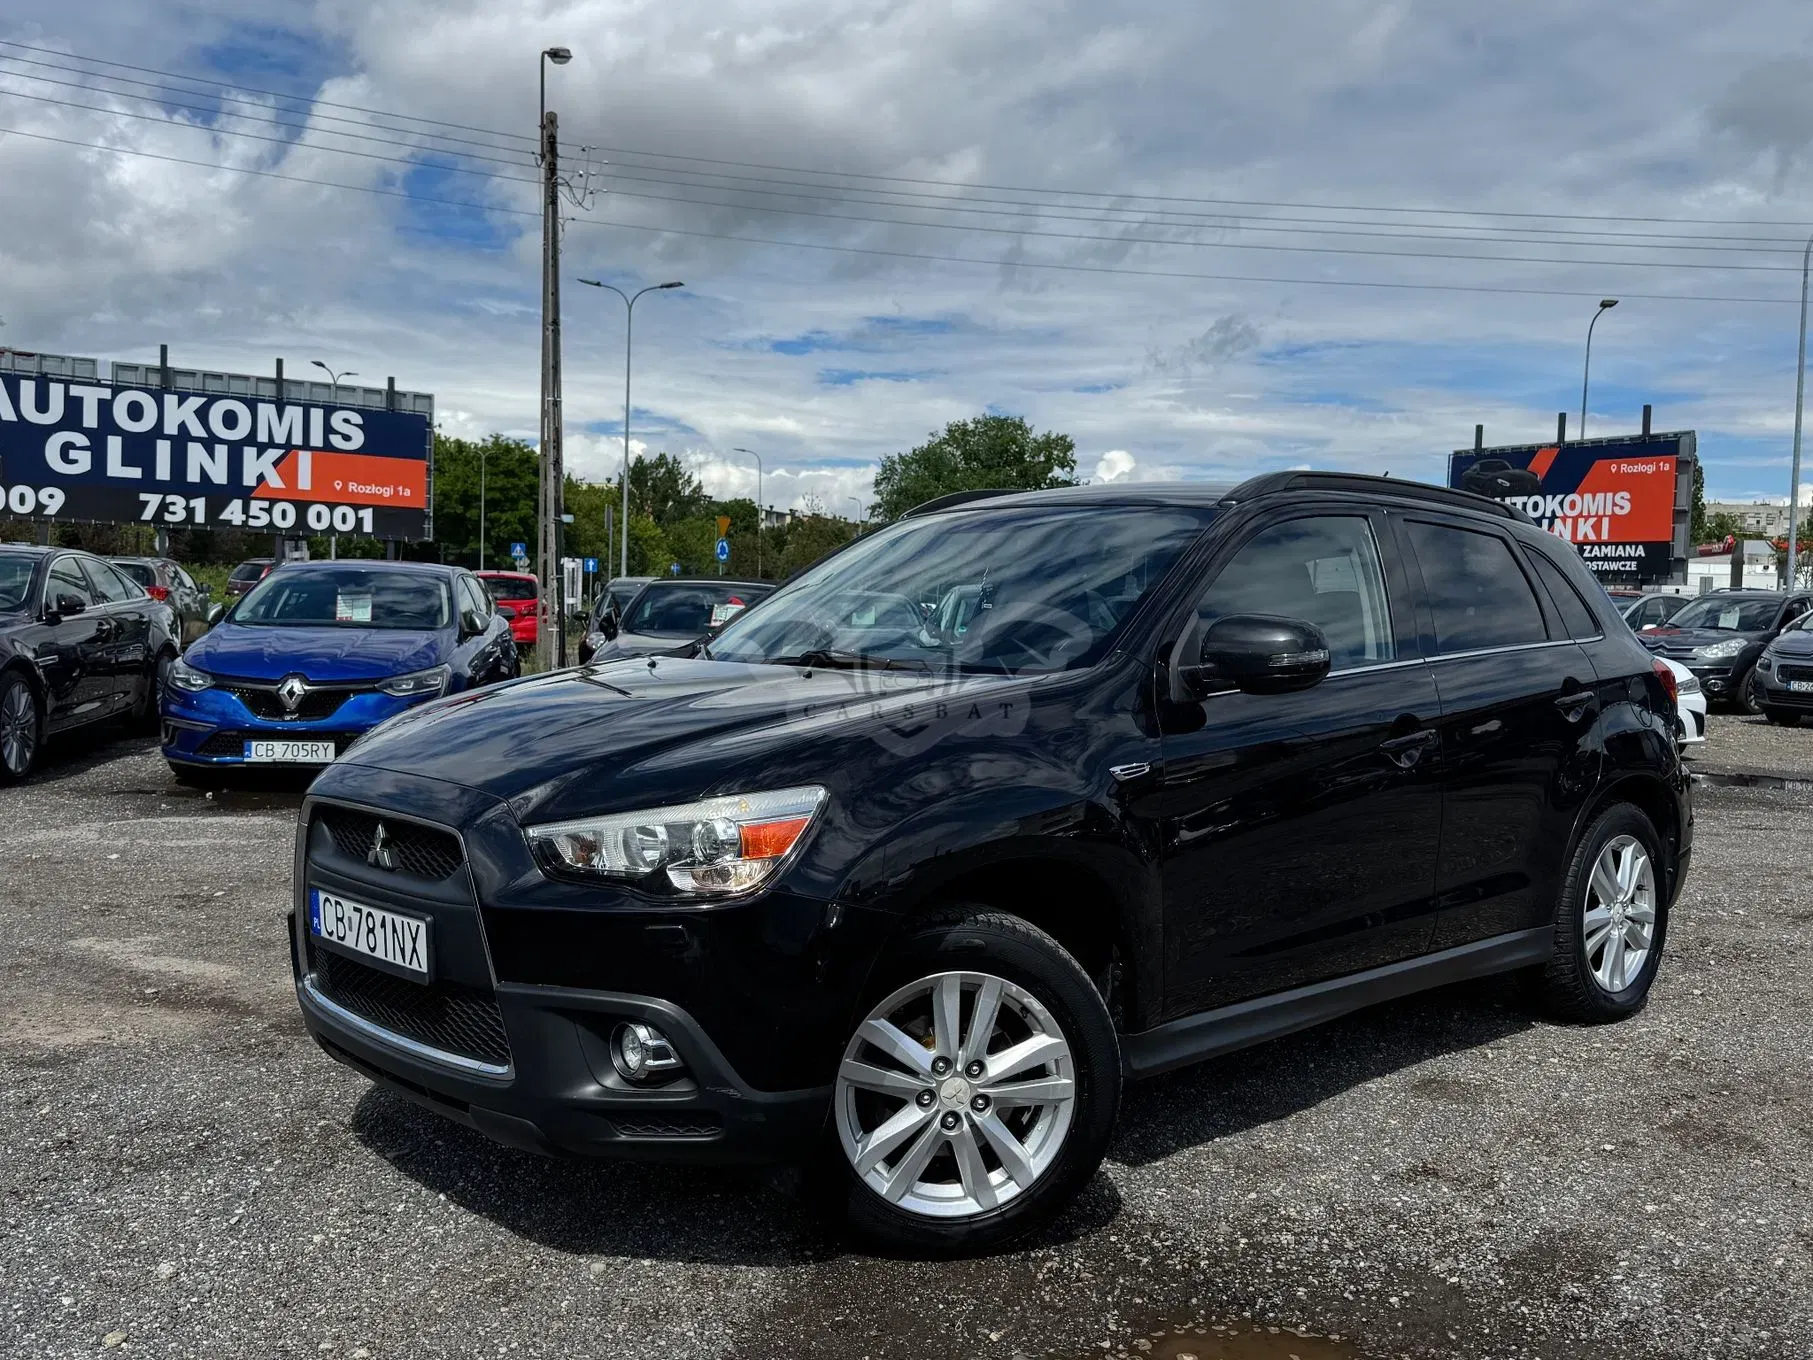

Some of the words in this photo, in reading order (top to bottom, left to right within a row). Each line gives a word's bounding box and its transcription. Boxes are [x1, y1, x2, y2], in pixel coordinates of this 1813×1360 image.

[45, 431, 312, 490] GLINKI
[1659, 461, 1670, 471] 1a
[0, 484, 66, 516] 09
[348, 481, 394, 498] Rozłogi
[397, 485, 411, 497] 1a
[139, 493, 206, 524] 731
[219, 498, 297, 529] 450
[307, 504, 373, 533] 001
[1494, 491, 1632, 518] TOKOMIS
[1541, 516, 1609, 541] INKI
[1582, 544, 1646, 558] ZAMIANA
[1585, 560, 1638, 571] OSTAWCZE
[255, 743, 275, 758] CB
[281, 743, 330, 758] 705RY
[322, 896, 346, 942] CB
[352, 906, 422, 969] 781NX
